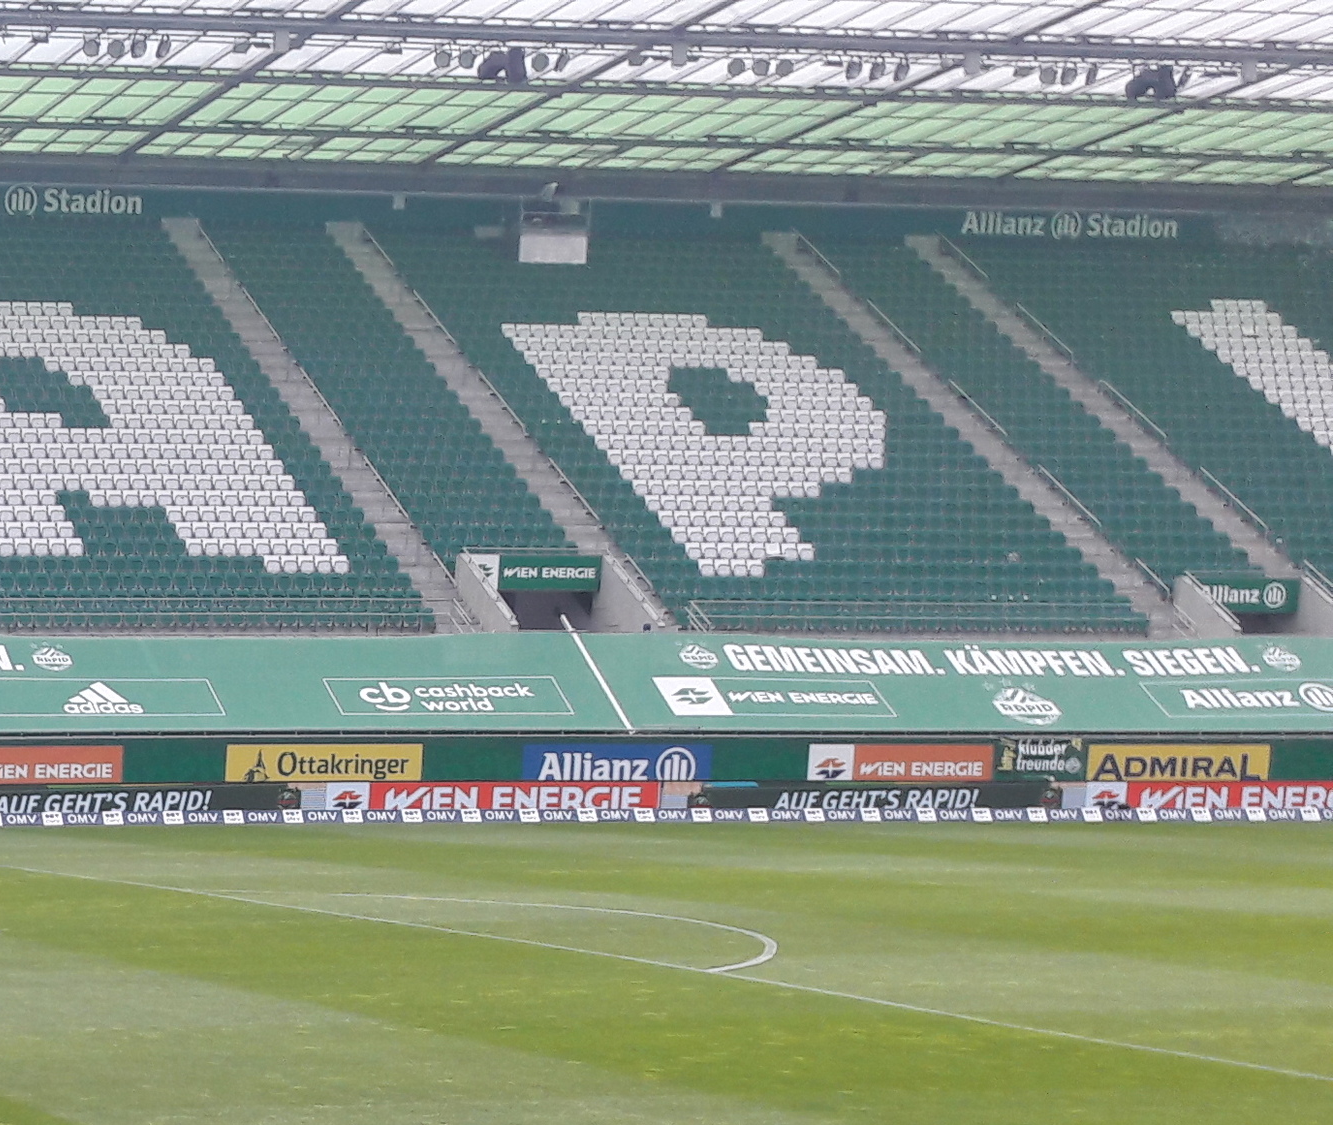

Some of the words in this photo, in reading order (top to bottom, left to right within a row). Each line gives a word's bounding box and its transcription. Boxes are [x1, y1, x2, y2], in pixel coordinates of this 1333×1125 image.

[43, 188, 143, 215] Stadion
[961, 211, 1045, 236] Allianz
[1086, 213, 1178, 239] Stadion
[503, 567, 538, 578] WIEN
[541, 567, 596, 579] ENERGIE
[722, 644, 946, 677] GEMEINSAM.
[948, 643, 1126, 677] KÄMPFEN.
[1123, 645, 1262, 677] SIEGEN.
[415, 682, 535, 700] cashback
[727, 690, 785, 703] WIEN
[787, 691, 879, 705] ENERGIE
[1179, 688, 1302, 709] Allianz
[63, 701, 144, 714] adidas
[420, 696, 494, 713] world
[34, 763, 113, 779] ENERGIE
[277, 751, 409, 782] Ottakringer
[539, 751, 649, 781] Allianz
[859, 761, 907, 776] WIEN
[911, 760, 983, 777] ENERGIE
[1092, 754, 1261, 782] ADMIRAL
[44, 792, 127, 814] GEHT'S
[133, 790, 212, 813] RAPID!
[384, 786, 479, 810] WIEN
[491, 786, 642, 810] ENERGIE
[774, 791, 821, 810] AUF
[822, 789, 901, 810] GEHT'S
[906, 788, 980, 810] RAPID!
[1139, 785, 1229, 810] WIEN
[7, 815, 37, 825] OMV
[67, 814, 98, 824] OMV
[128, 814, 158, 823] OMV
[188, 813, 218, 822] OMV
[248, 812, 278, 822] OMV
[308, 812, 338, 821] OMV
[367, 811, 396, 821] OMV
[427, 811, 456, 820] OMV
[485, 811, 514, 820] OMV
[544, 810, 572, 820] OMV
[601, 810, 630, 820] OMV
[659, 810, 687, 820] OMV
[715, 810, 744, 820] OMV
[772, 810, 800, 820] OMV
[828, 810, 856, 820] OMV
[884, 810, 913, 819] OMV
[940, 810, 968, 819] OMV
[995, 810, 1023, 819] OMV
[1050, 810, 1078, 819] OMV
[1160, 810, 1187, 819] OMV
[1215, 810, 1242, 819] OMV
[1268, 810, 1296, 819] OMV
